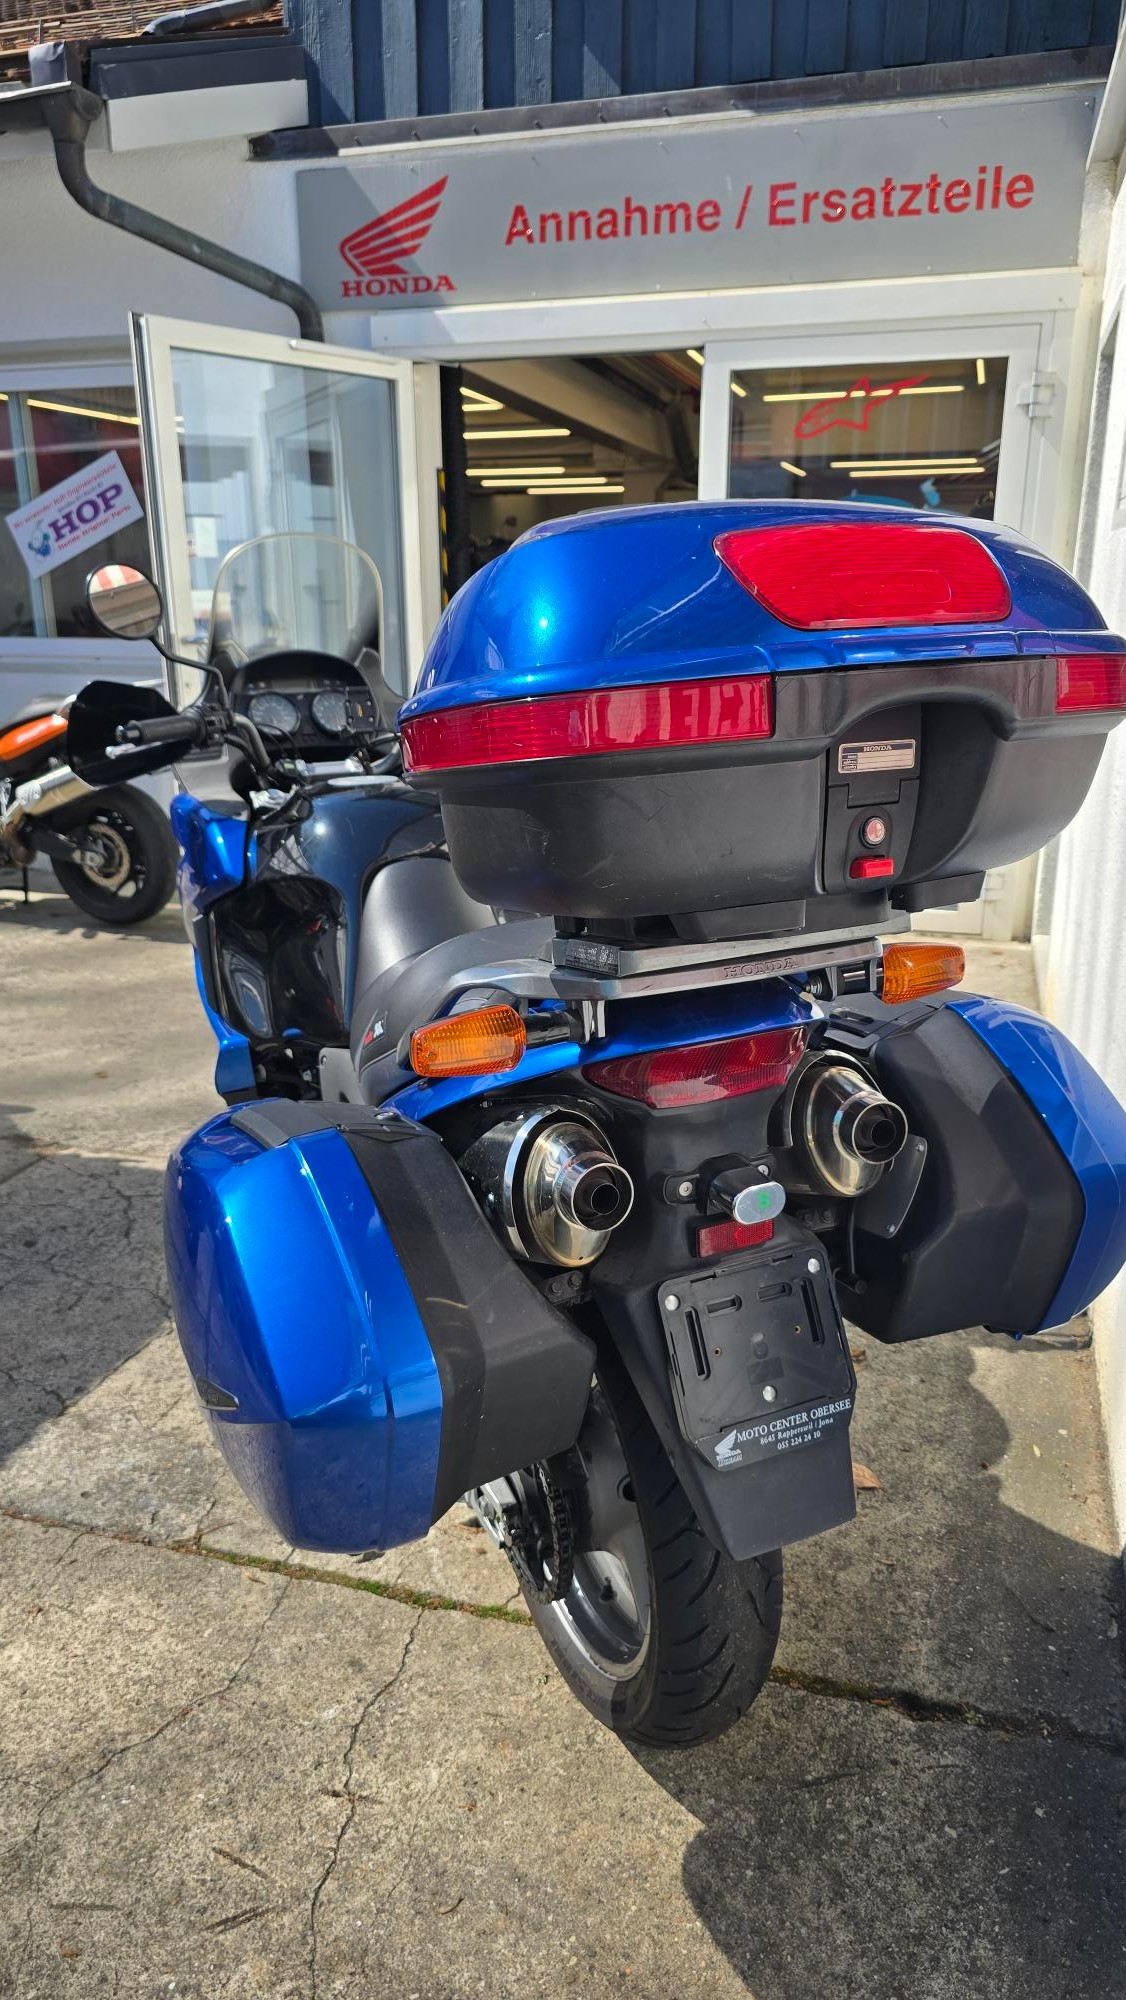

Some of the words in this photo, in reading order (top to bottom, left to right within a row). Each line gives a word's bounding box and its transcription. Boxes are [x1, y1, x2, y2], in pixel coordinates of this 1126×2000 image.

[503, 196, 721, 246] Annahme
[735, 185, 753, 229] /
[768, 166, 1035, 226] Ersatzteile
[341, 275, 458, 298] HONDA
[48, 483, 123, 542] HOP
[81, 515, 110, 536] Original
[724, 957, 799, 979] HONDA
[736, 1424, 768, 1443] MOTO
[769, 1412, 808, 1432] CENTER
[810, 1398, 852, 1420] OBERSEE
[760, 1435, 776, 1445] 8645
[777, 1422, 813, 1440] Rapperswil
[818, 1417, 834, 1428] Jona
[777, 1441, 789, 1450] 055
[791, 1437, 802, 1447] 224
[804, 1434, 812, 1443] 24
[813, 1430, 821, 1440] 10
[716, 1449, 742, 1460] HONDA
